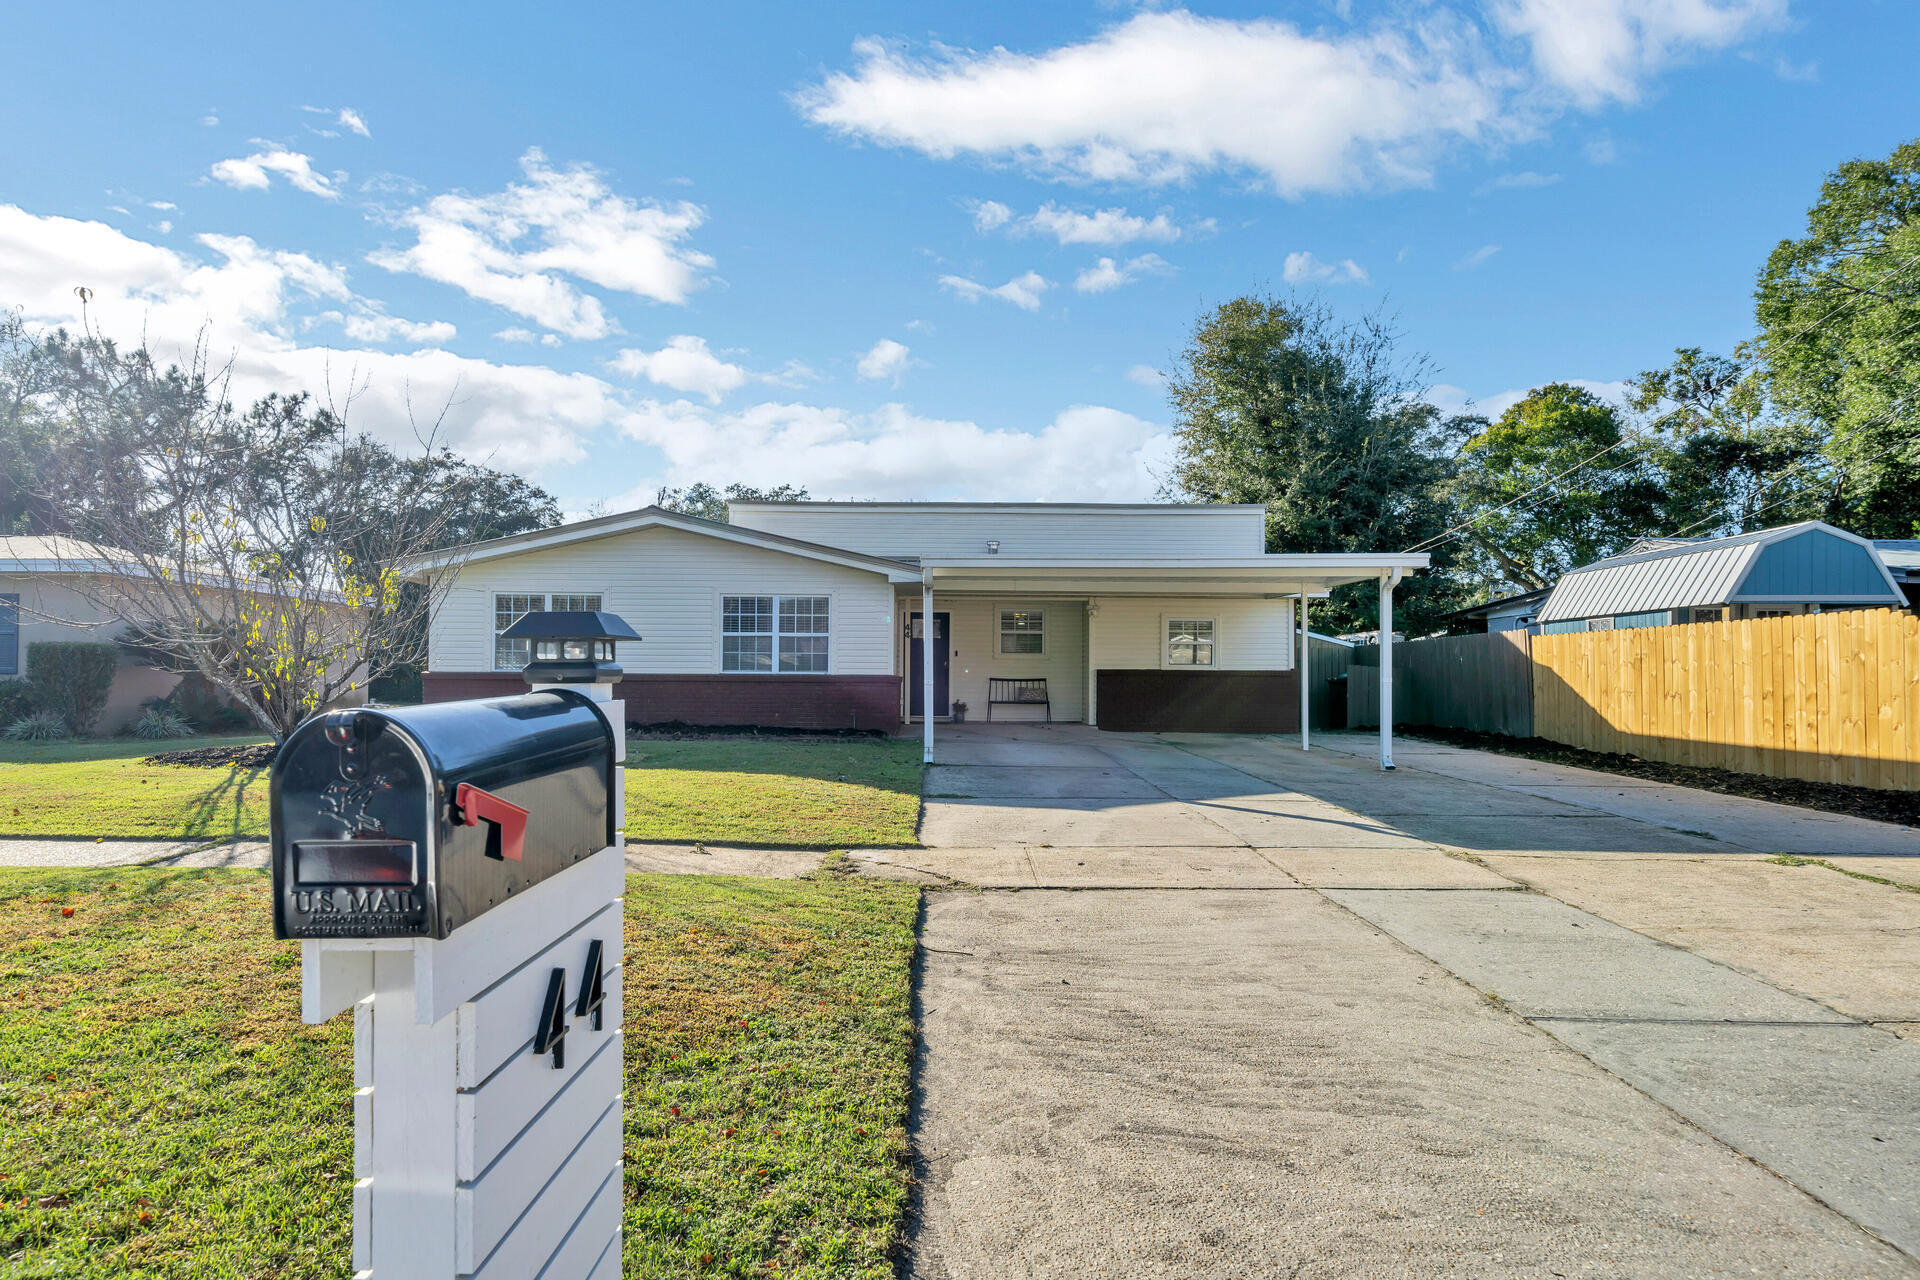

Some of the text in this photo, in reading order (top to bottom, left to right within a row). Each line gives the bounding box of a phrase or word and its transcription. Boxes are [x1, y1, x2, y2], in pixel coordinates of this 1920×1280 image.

[904, 624, 912, 638] 44
[290, 888, 422, 914] U.S. MAIL
[533, 939, 607, 1069] 44
